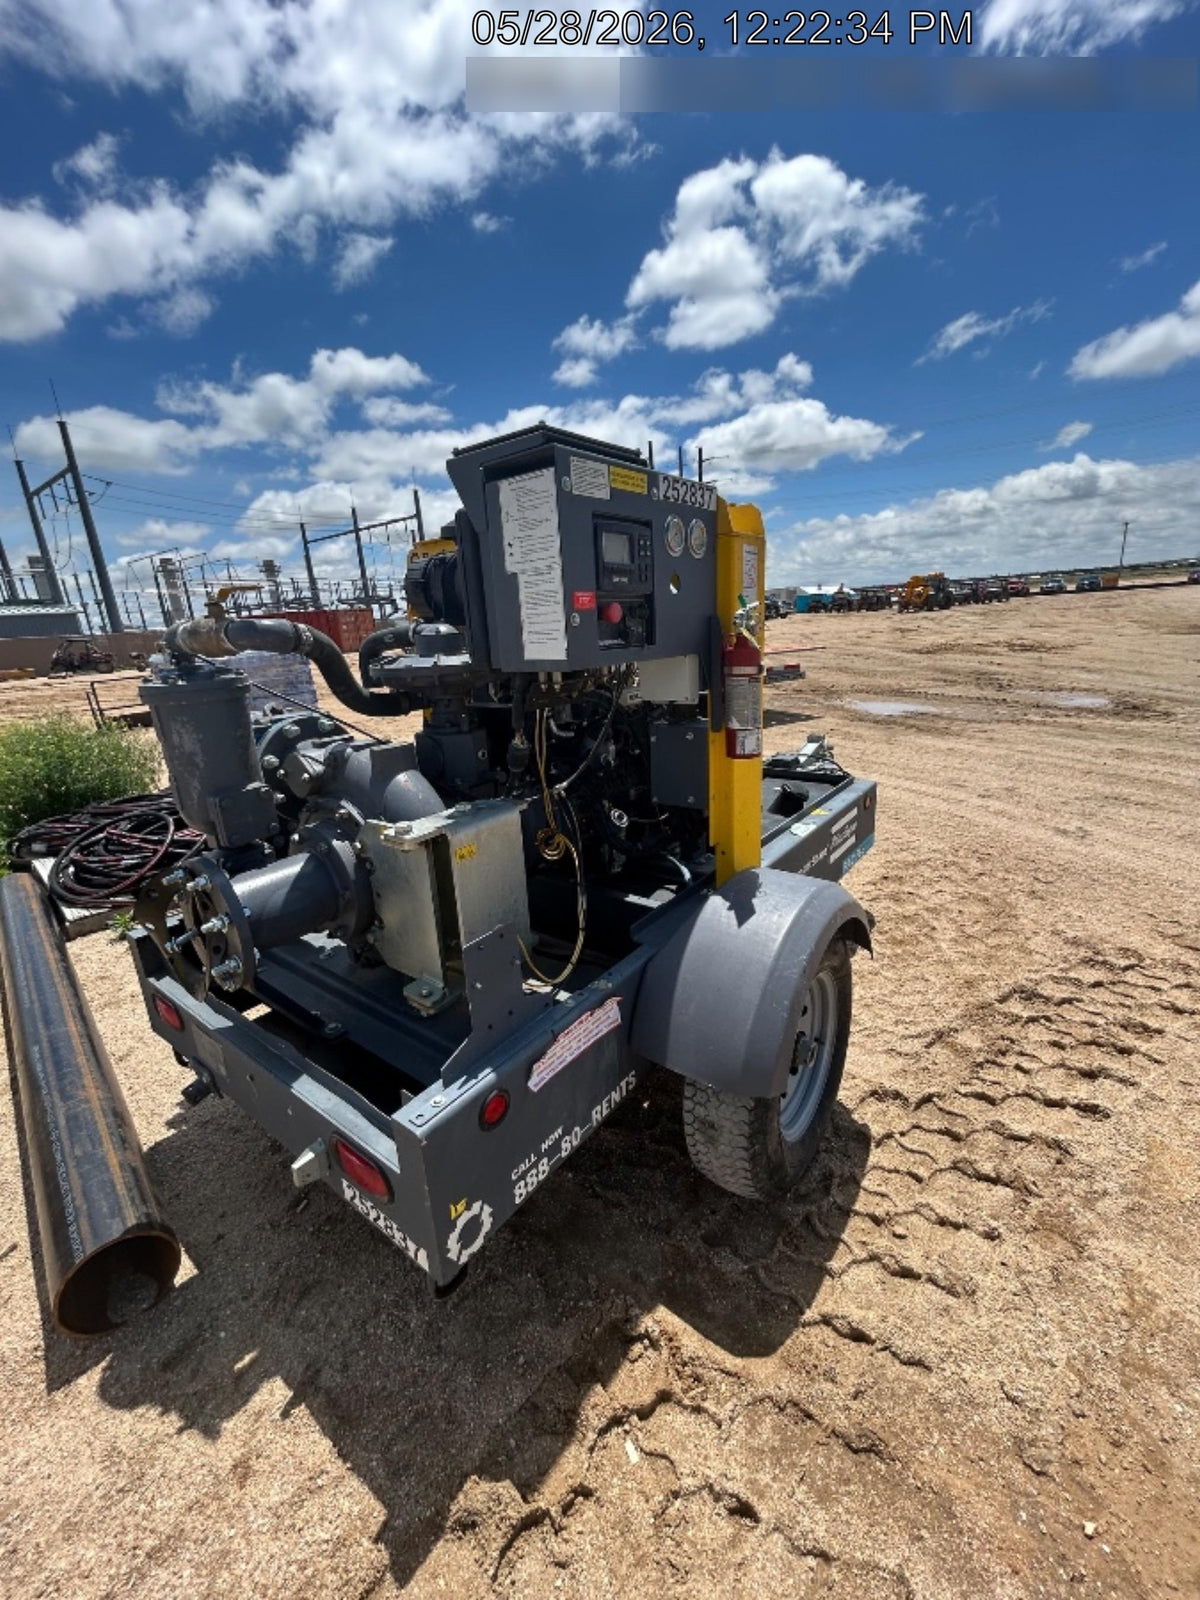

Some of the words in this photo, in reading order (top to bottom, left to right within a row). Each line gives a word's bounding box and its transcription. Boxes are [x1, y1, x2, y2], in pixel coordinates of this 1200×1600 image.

[662, 476, 714, 510] 252837
[511, 1153, 537, 1180] CALL
[541, 1125, 563, 1152] NOW
